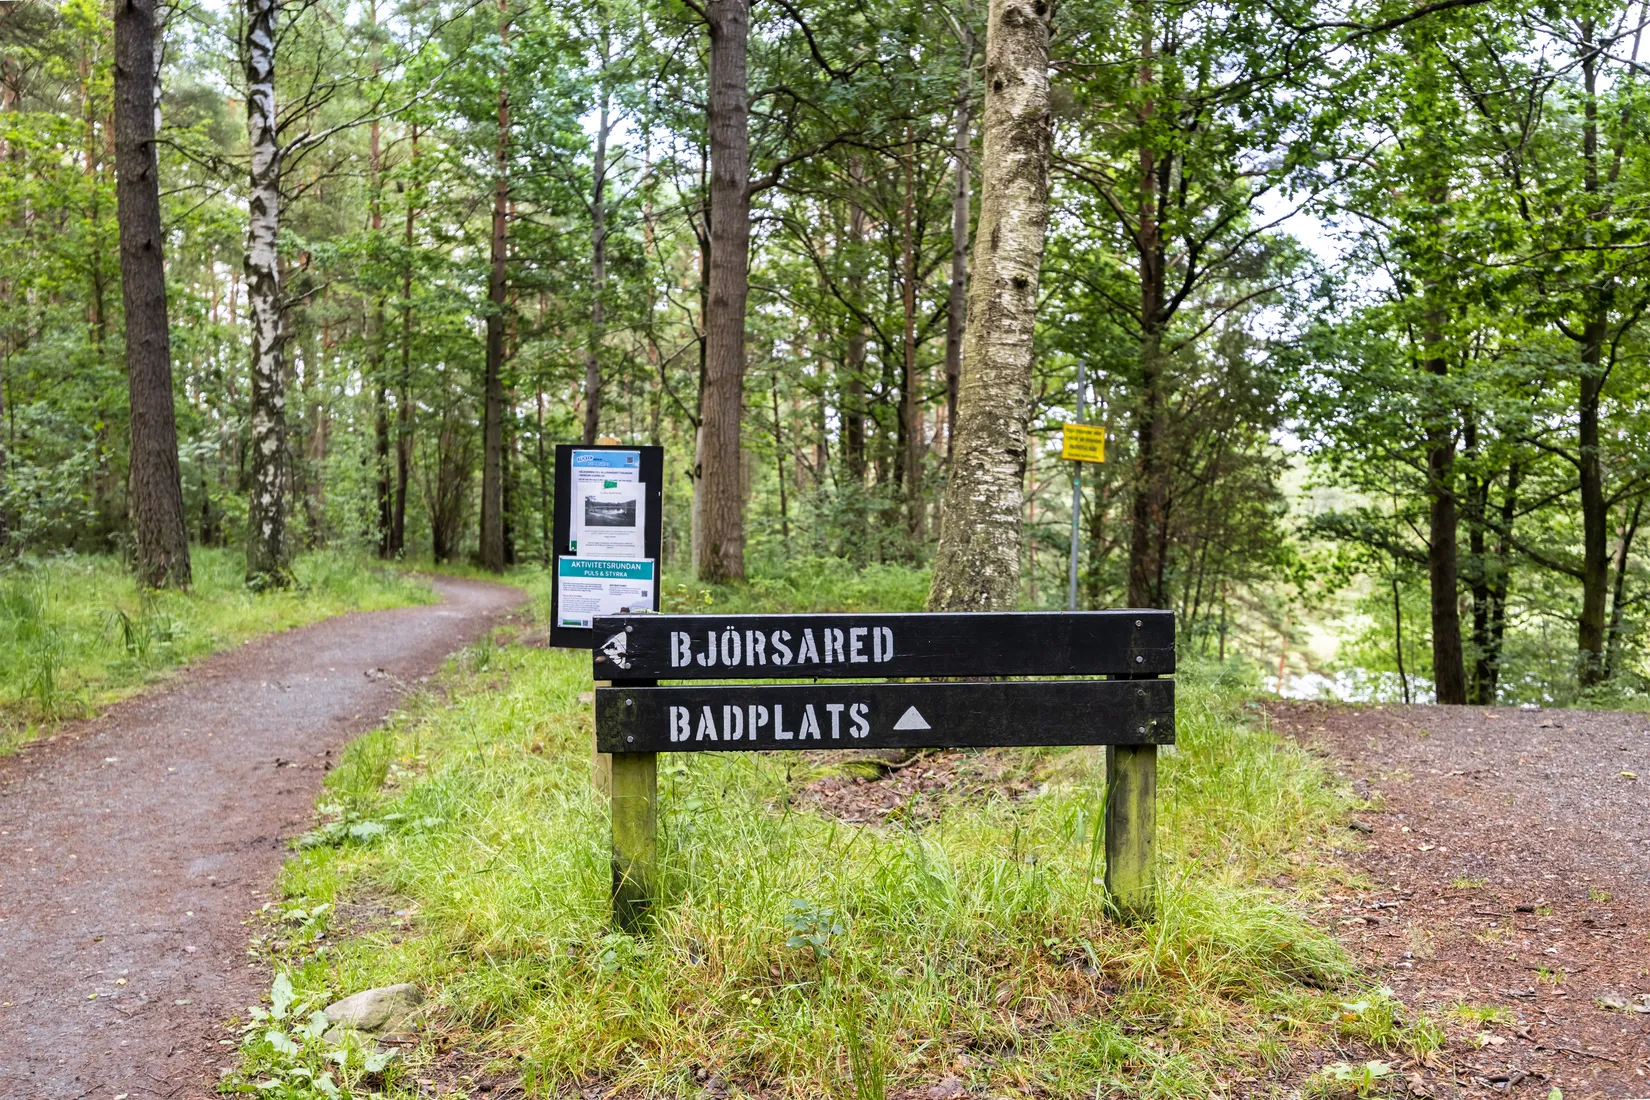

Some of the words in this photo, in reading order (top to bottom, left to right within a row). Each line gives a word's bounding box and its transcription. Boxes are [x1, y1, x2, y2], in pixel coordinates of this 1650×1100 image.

[571, 561, 641, 570] AKTIVITETSRUNDAN
[670, 626, 894, 667] BJÖRSARED
[669, 703, 870, 742] BADPLATS
